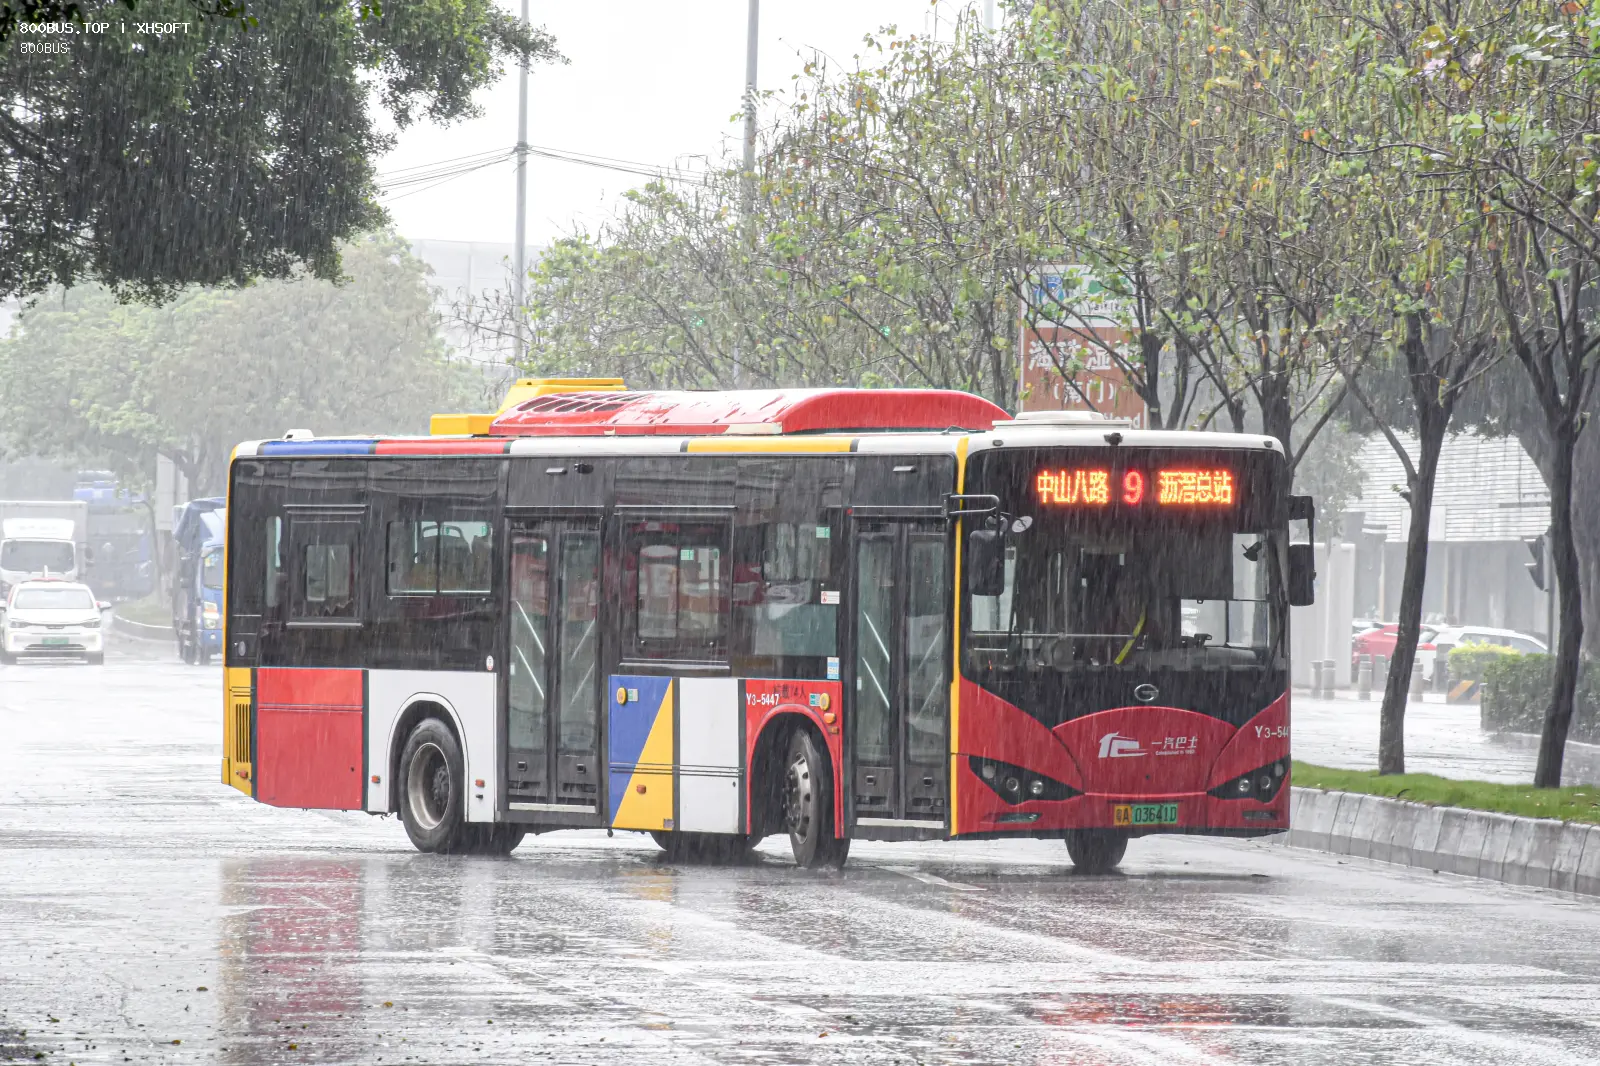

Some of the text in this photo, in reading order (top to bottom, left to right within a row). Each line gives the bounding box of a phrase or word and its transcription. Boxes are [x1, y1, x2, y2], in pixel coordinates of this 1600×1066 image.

[1037, 470, 1232, 504] 中山八路 9 沥滘总站
[746, 692, 780, 706] Y3-5447
[1151, 735, 1198, 750] 一汽巴士
